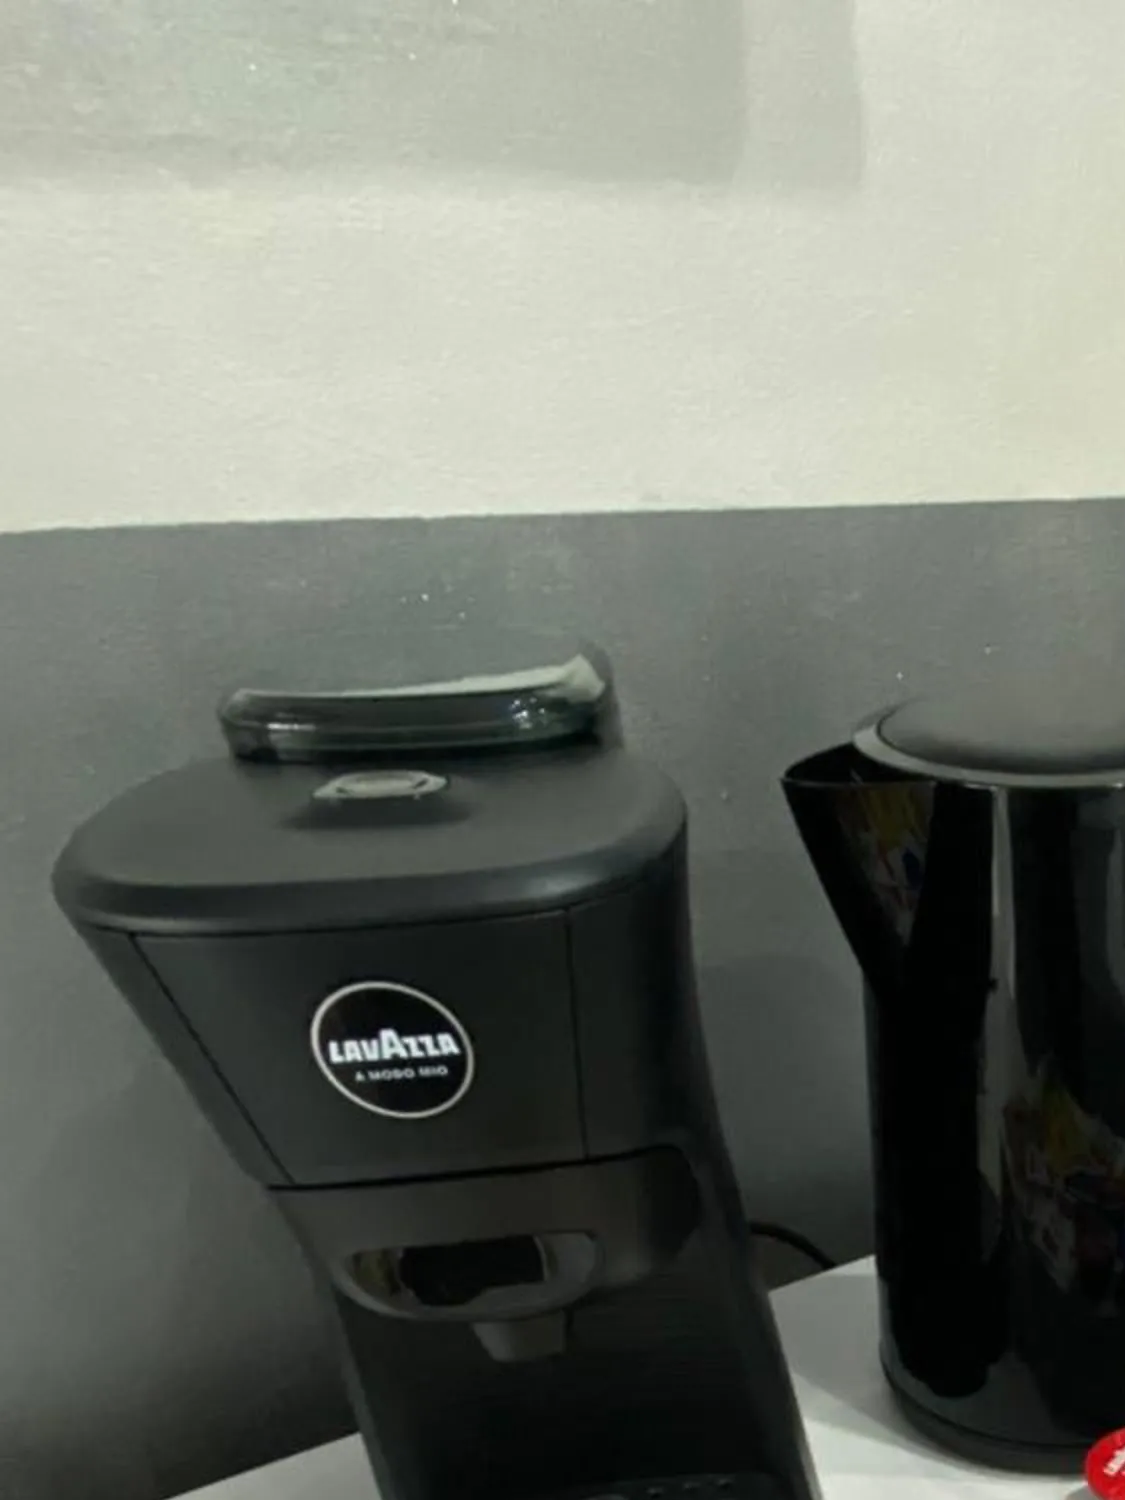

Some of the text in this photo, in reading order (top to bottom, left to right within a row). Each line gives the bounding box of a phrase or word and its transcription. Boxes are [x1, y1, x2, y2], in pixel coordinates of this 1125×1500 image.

[328, 1028, 460, 1063] LAVAZZA
[355, 1064, 449, 1081] A MODO MIO
